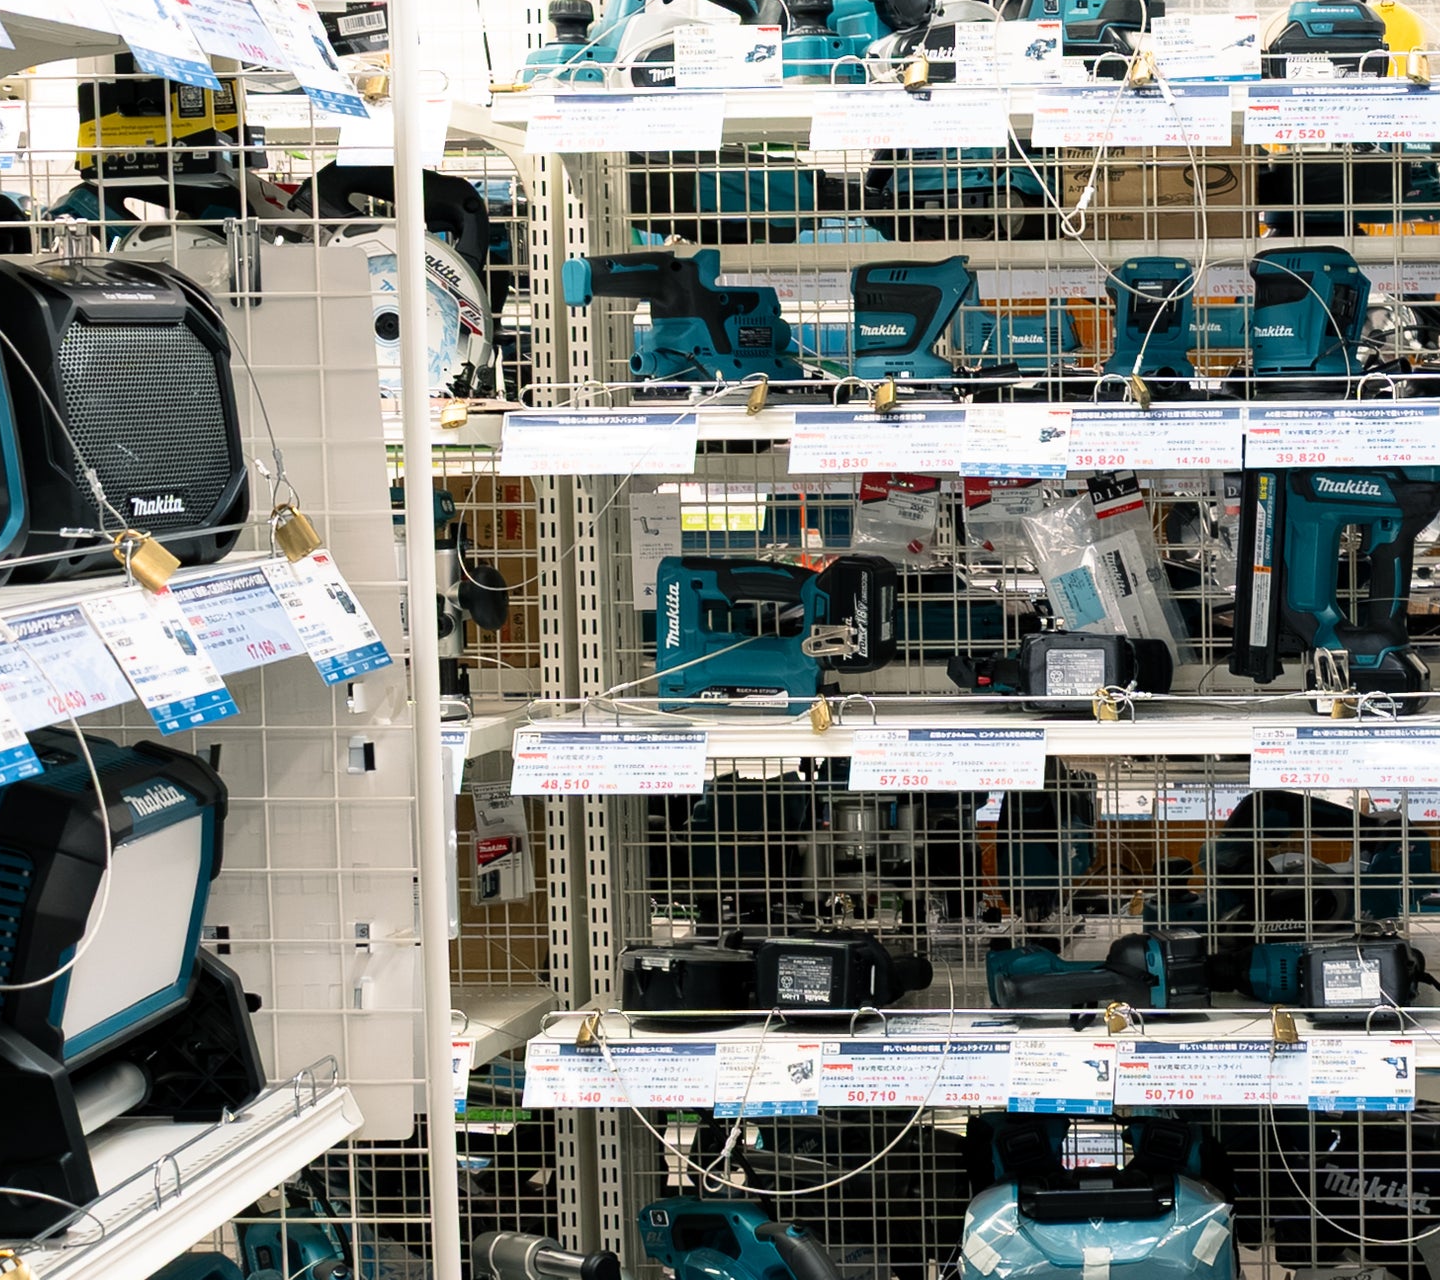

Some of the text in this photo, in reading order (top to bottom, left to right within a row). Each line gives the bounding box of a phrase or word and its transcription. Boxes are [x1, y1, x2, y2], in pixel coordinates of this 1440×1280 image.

[1274, 129, 1326, 140] 47,520
[858, 322, 909, 339] Makita
[1075, 455, 1125, 466] 39,820
[1175, 456, 1211, 465] 14,740
[1275, 452, 1326, 464] 39,820
[1375, 453, 1412, 462] 14,740
[1312, 474, 1384, 501] Makita
[129, 493, 186, 518] Makita
[665, 581, 680, 650] Makita
[879, 775, 929, 787] 57,530
[1279, 773, 1330, 784] 62,370
[120, 783, 188, 818] Makita
[650, 1094, 685, 1103] 36,410
[847, 1090, 897, 1102] 50,710
[1144, 1089, 1195, 1101] 50,710
